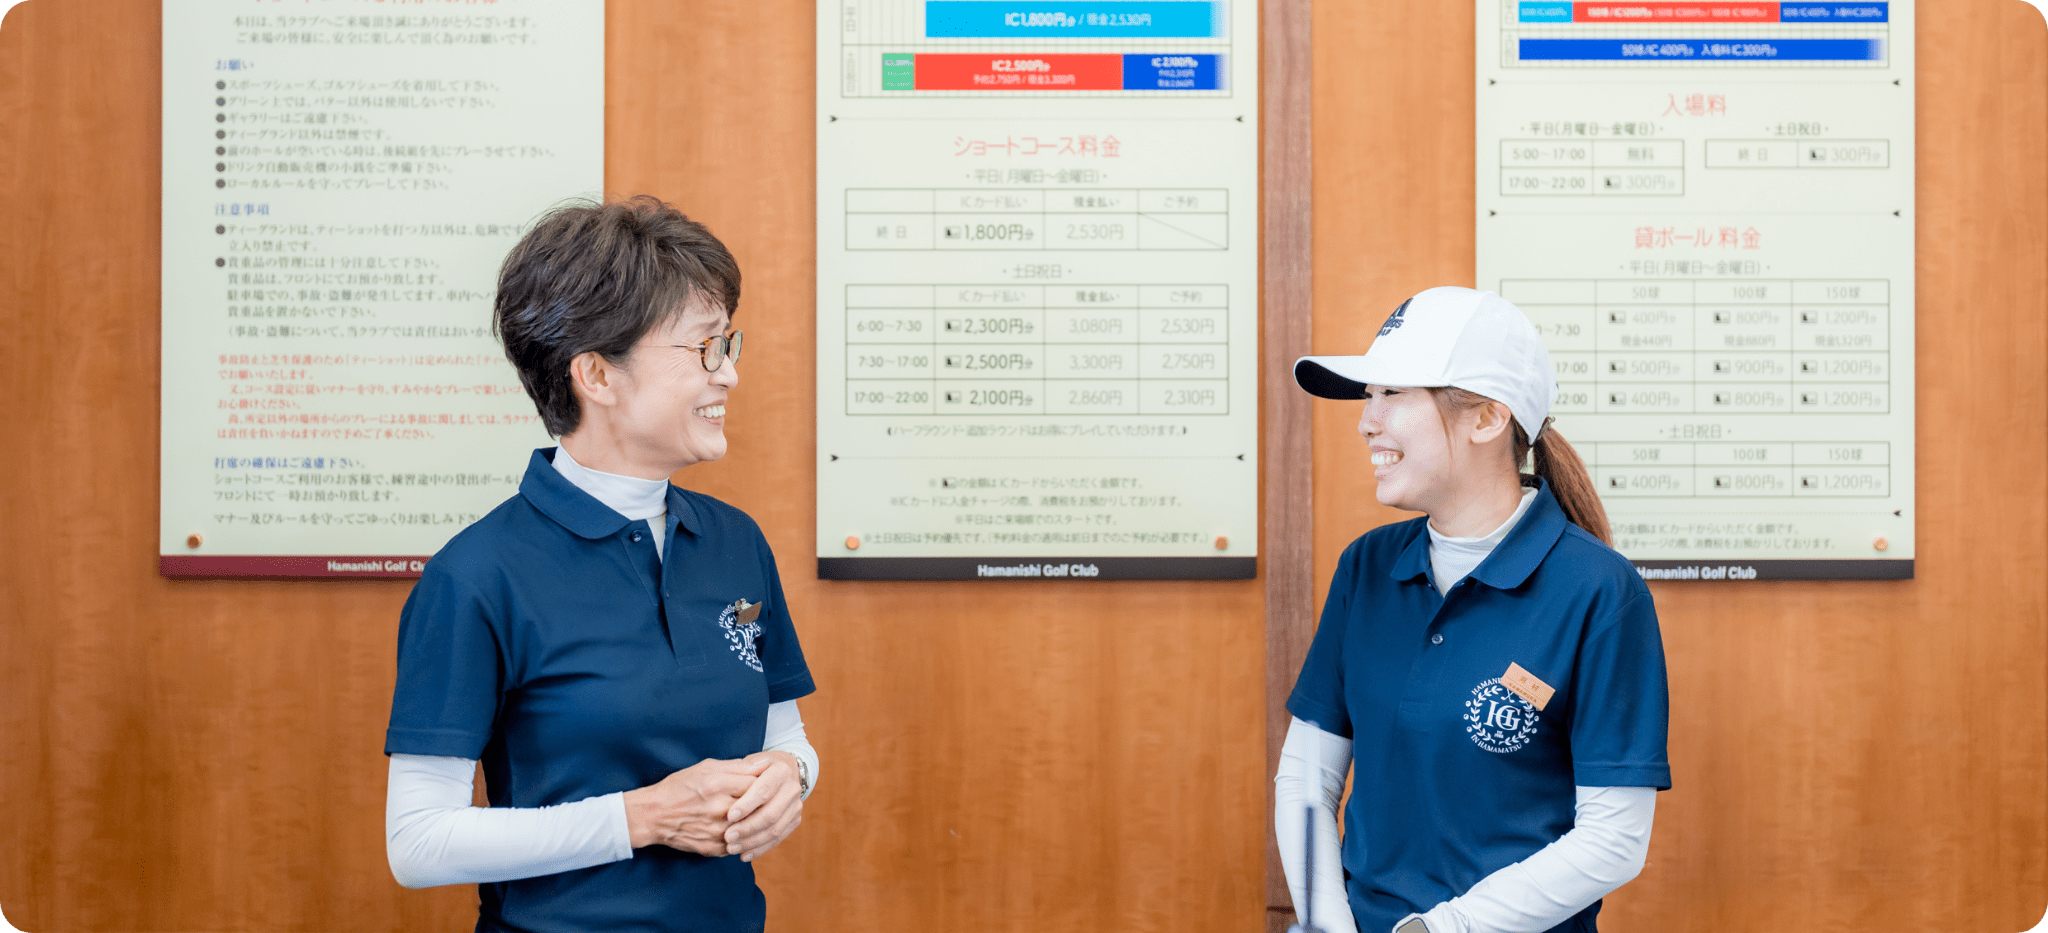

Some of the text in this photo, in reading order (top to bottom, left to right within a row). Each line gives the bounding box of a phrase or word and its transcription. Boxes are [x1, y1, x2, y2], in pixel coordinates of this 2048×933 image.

[215, 59, 254, 72] お願い
[1662, 93, 1727, 117] 入場料
[953, 135, 1121, 158] ショートコース料金
[1627, 147, 1654, 161] 無料
[960, 195, 1199, 209] ICカード払い 現金払い ご予約
[215, 203, 270, 217] 注意事項
[1066, 223, 1124, 241] 2,530円
[229, 239, 317, 252] 立入り禁止です。
[958, 289, 1202, 303] ICカード払い 現金払い ご予約
[1632, 286, 1861, 300] 50球 100球 150球
[1068, 318, 1123, 335] 3,080円
[1160, 318, 1215, 335] 2,530円
[1069, 354, 1123, 371] 3,300円
[1162, 354, 1215, 371] 2,750円
[1068, 389, 1123, 406] 2,860円
[1164, 389, 1215, 406] 2,310円
[1633, 448, 1863, 462] 50球 100球 150球
[327, 561, 383, 572] Hamanishi
[384, 560, 408, 572] Golf
[977, 563, 1099, 577] Hamanishi Golf Club
[1637, 566, 1757, 579] Hamanishi Golf Club
[1478, 741, 1522, 753] HAMAMATSU
